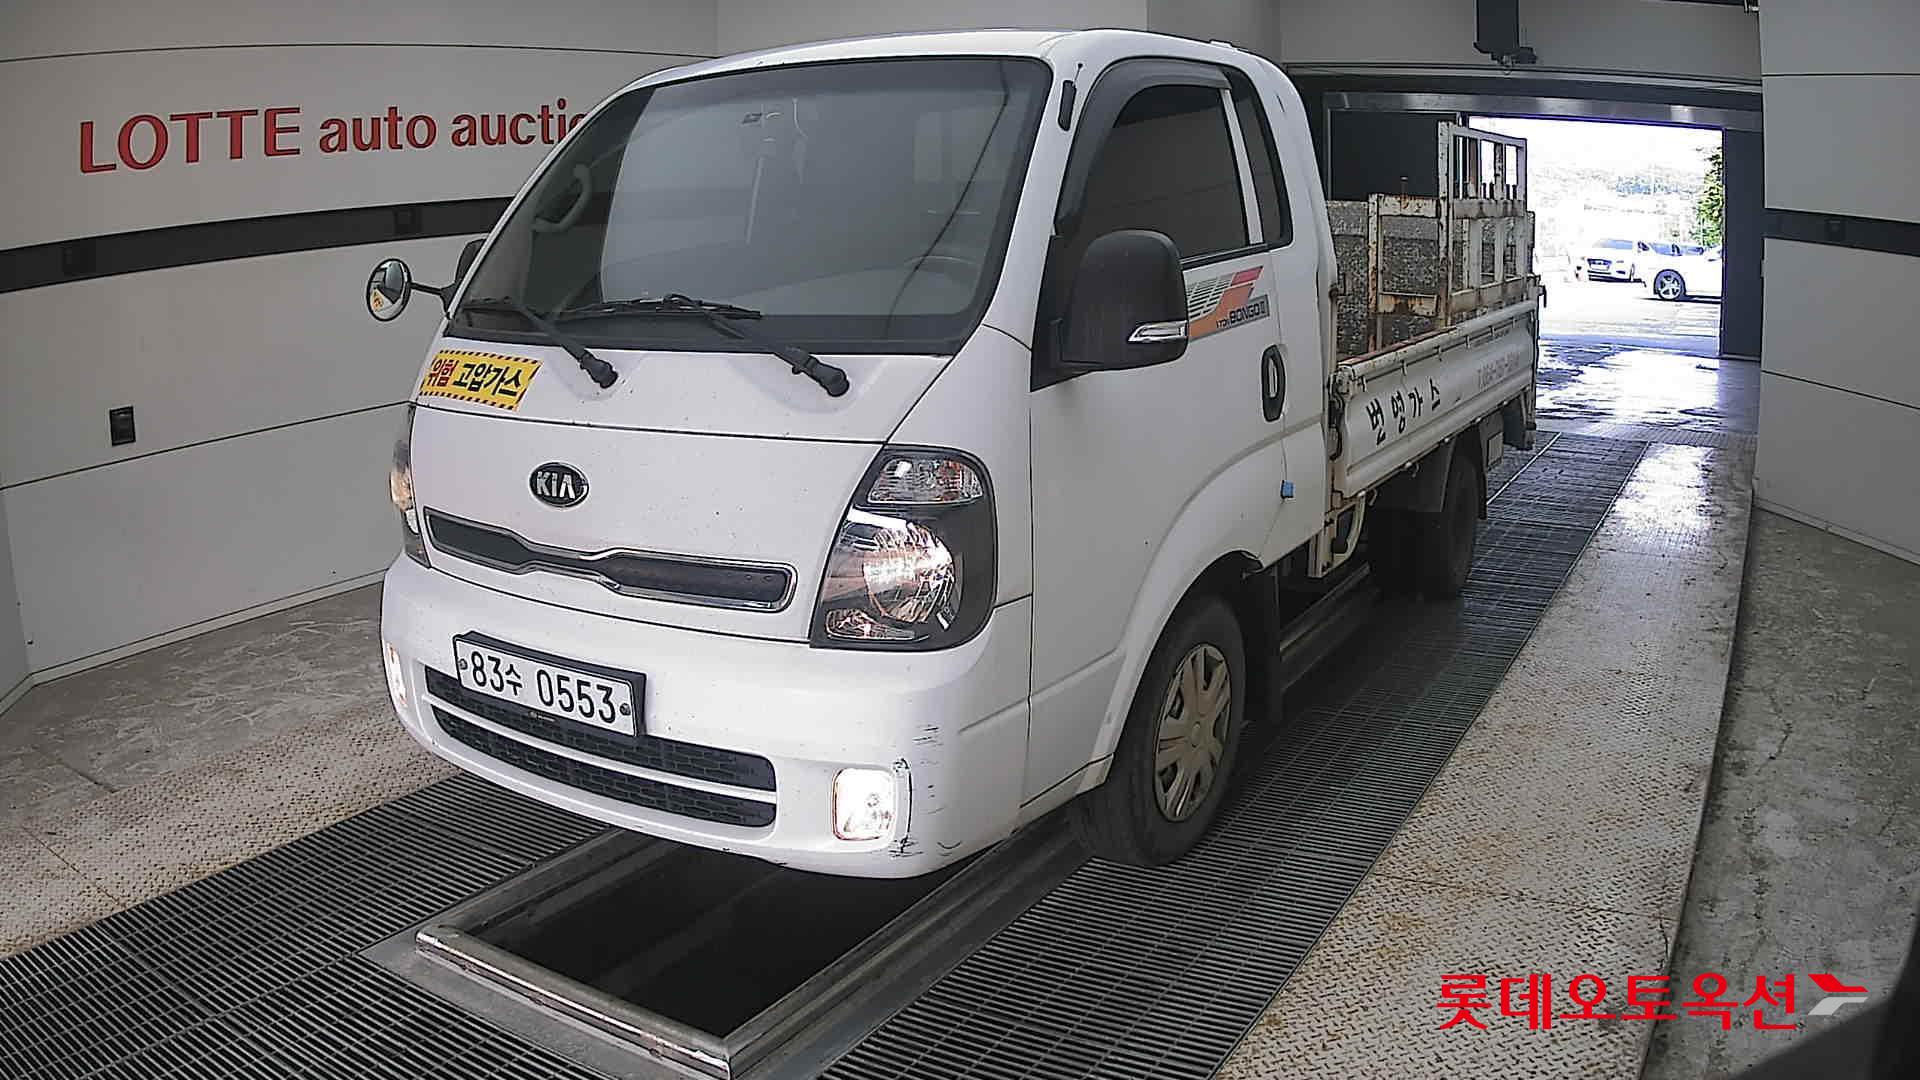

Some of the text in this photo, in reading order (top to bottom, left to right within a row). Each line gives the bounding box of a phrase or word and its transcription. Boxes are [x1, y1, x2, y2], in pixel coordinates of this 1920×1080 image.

[80, 106, 301, 174] LOTTE
[318, 105, 437, 153] auto
[427, 359, 522, 397] 위험 고압가스
[536, 471, 576, 499] KIA
[470, 650, 616, 724] 83수 0553
